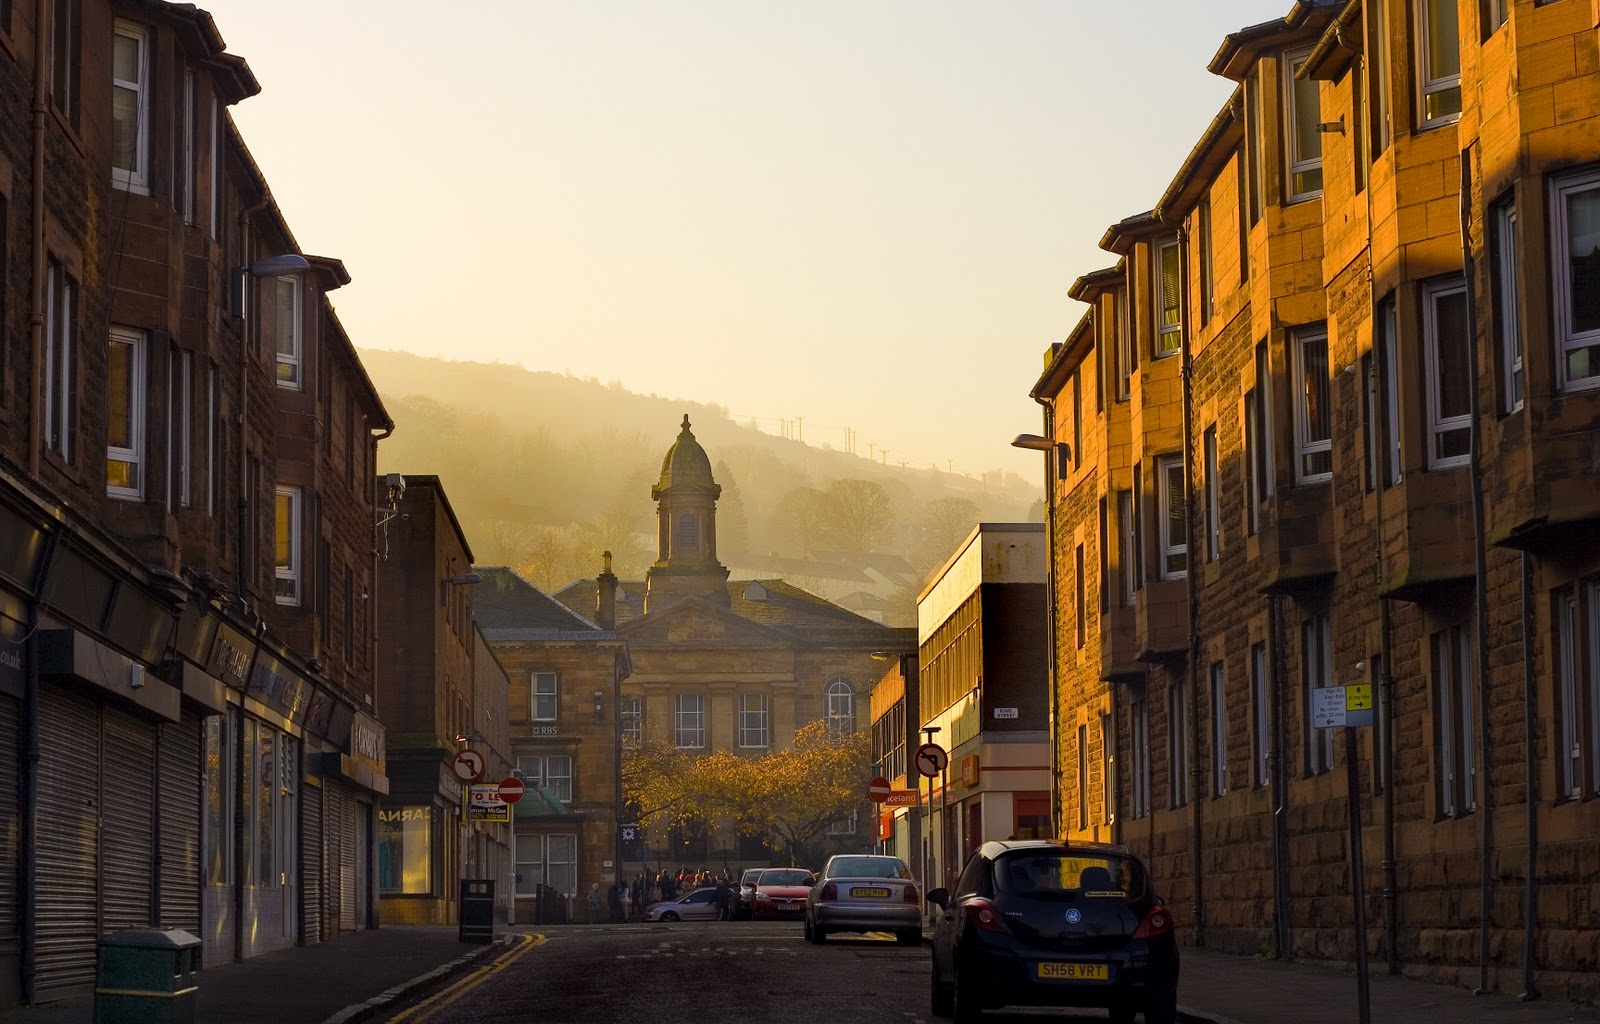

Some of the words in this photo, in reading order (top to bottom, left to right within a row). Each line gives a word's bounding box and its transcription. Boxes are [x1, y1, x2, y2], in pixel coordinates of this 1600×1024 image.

[541, 726, 558, 735] RBS
[1043, 964, 1075, 976] SH58
[1079, 965, 1103, 977] VRT
